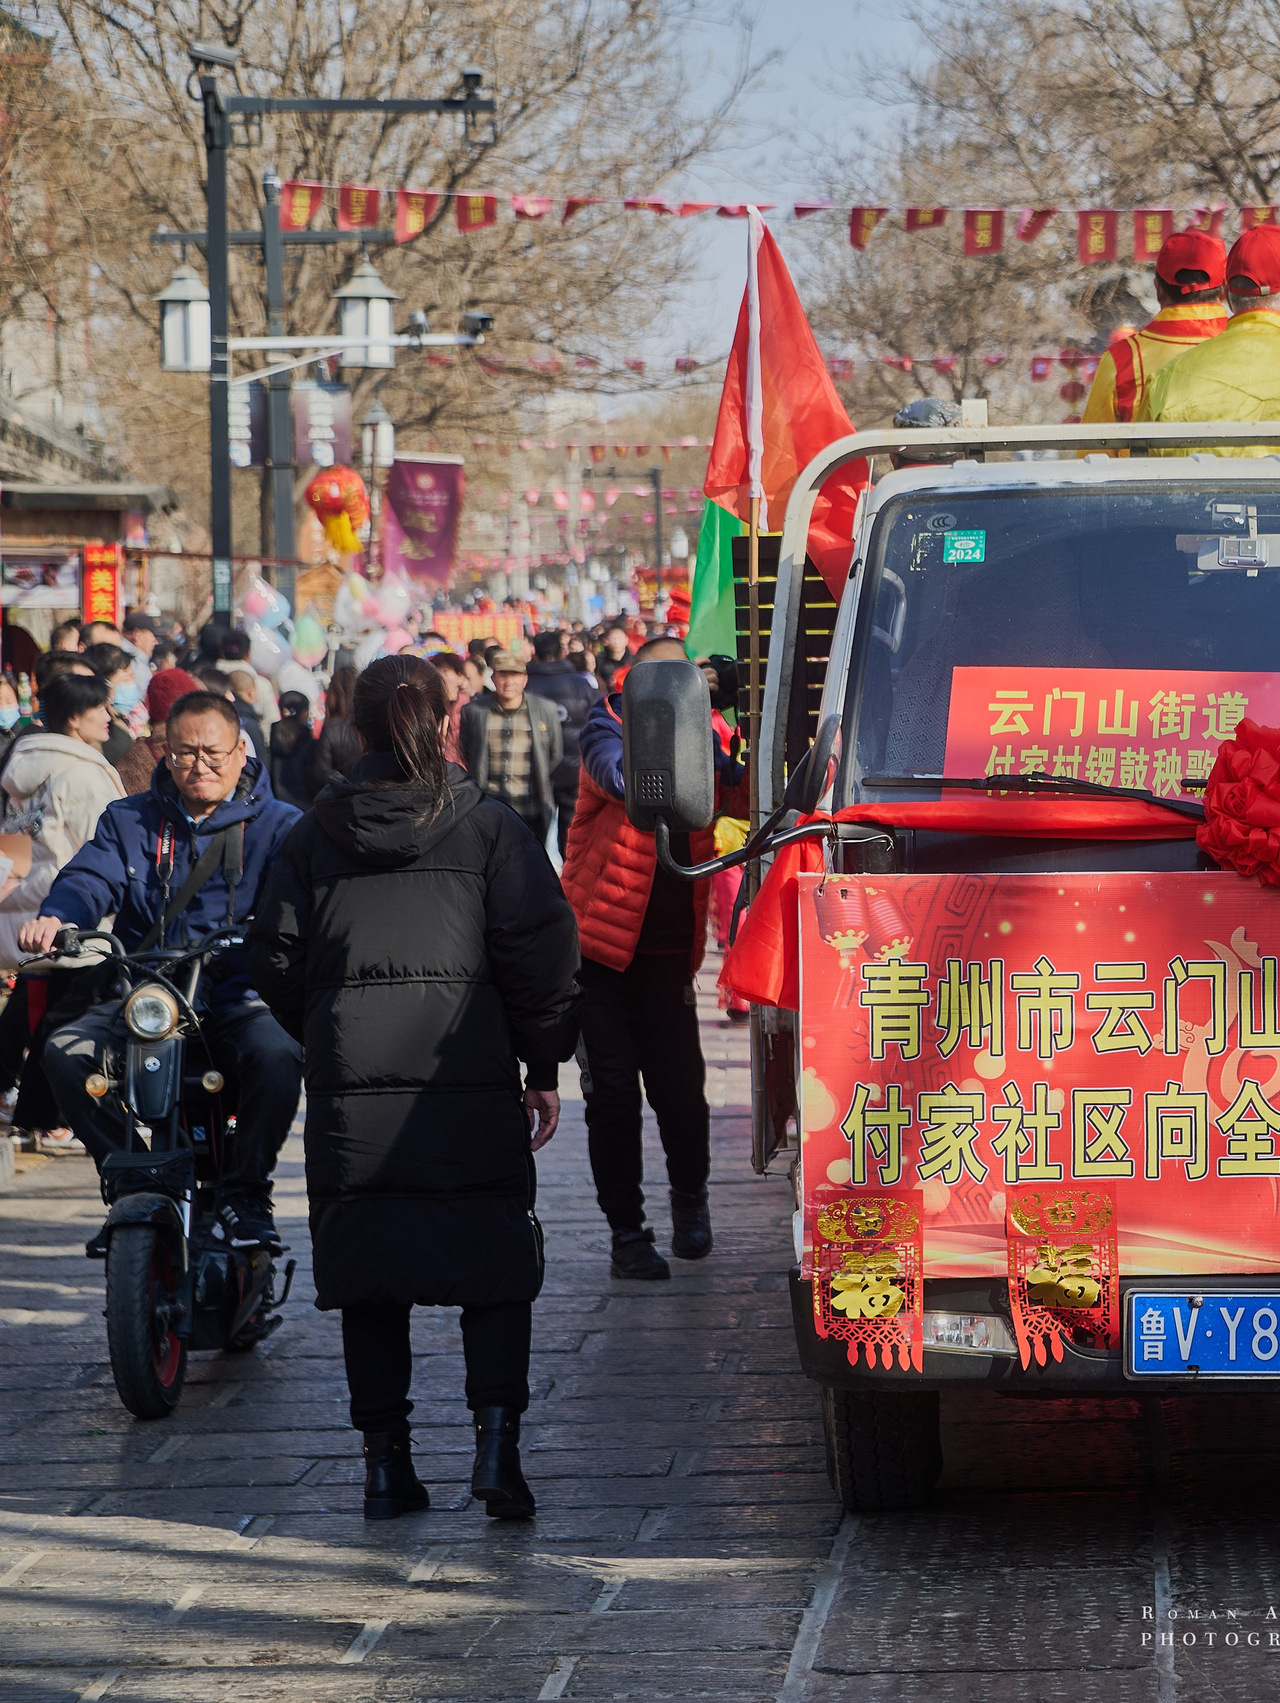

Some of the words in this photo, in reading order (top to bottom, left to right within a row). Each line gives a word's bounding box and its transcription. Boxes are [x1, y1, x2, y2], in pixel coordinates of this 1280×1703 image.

[948, 549, 981, 560] 2024
[987, 687, 1250, 741] 云门山街道
[830, 1251, 906, 1319] 福
[1025, 1244, 1101, 1309] 福
